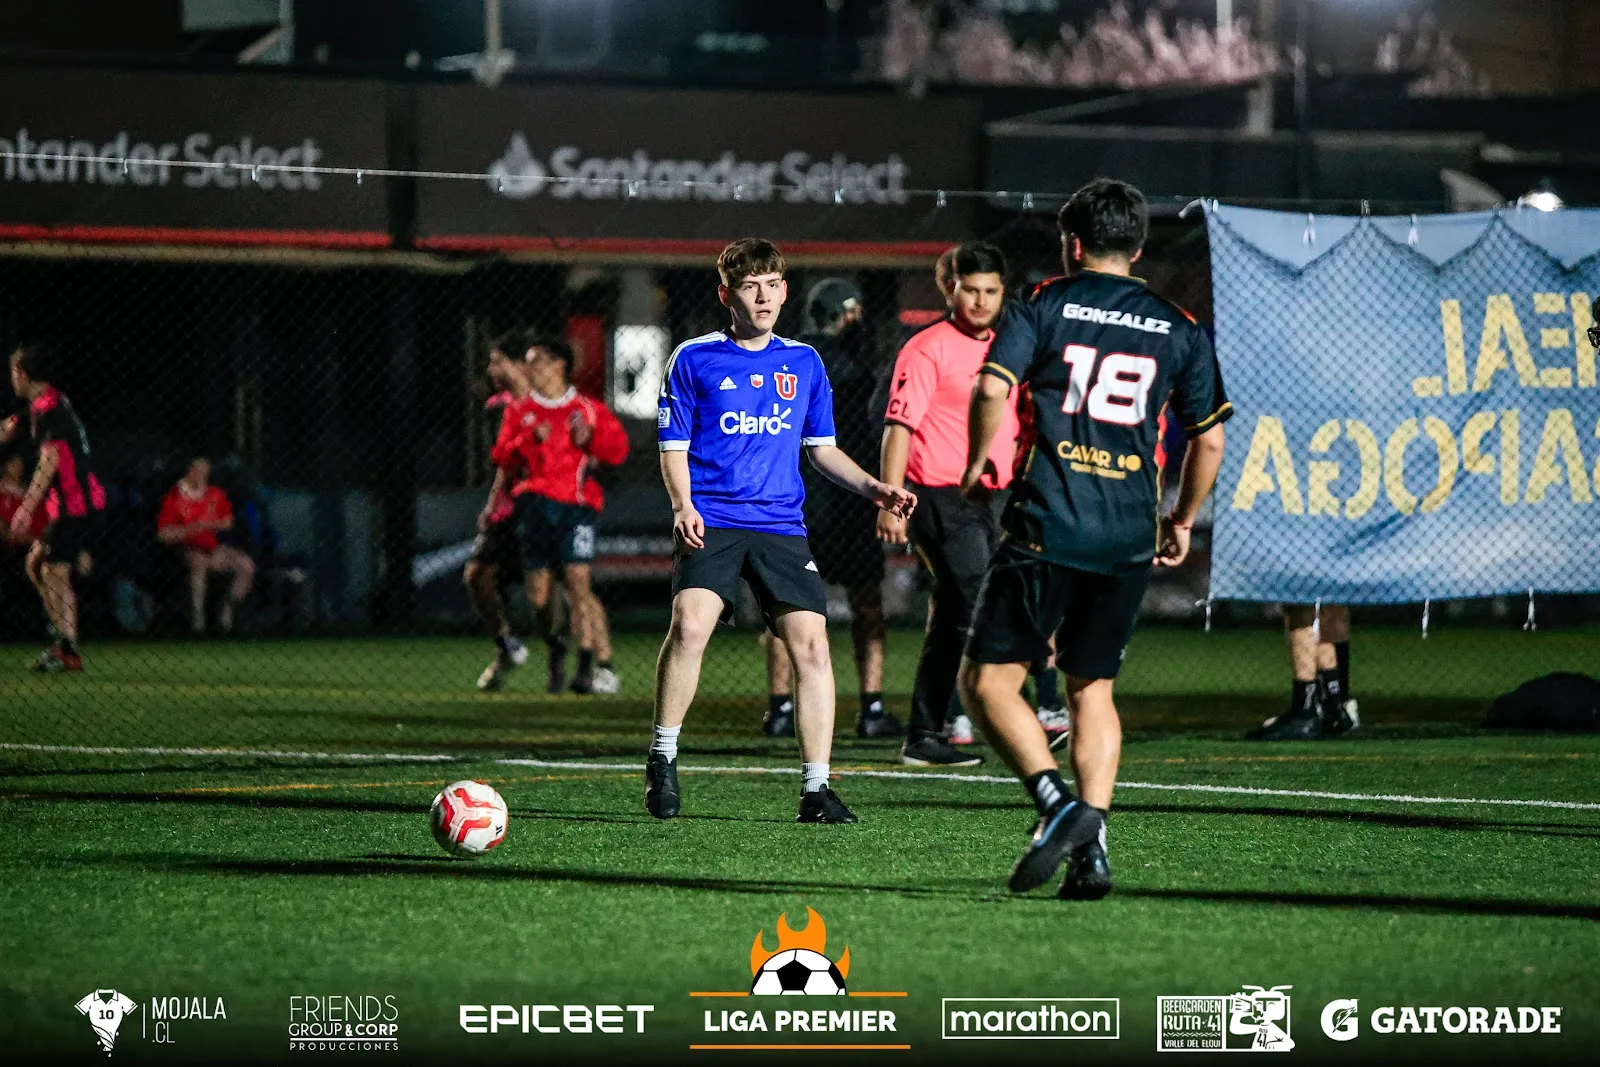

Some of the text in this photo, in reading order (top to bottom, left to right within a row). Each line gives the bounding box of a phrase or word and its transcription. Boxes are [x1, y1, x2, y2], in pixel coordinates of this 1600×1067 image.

[183, 133, 323, 191] Select
[550, 145, 908, 204] Santander Select
[1062, 302, 1172, 335] GONZALEZ
[774, 372, 798, 401] U
[1061, 343, 1157, 426] 18
[719, 410, 783, 436] Claro
[889, 398, 909, 420] CL
